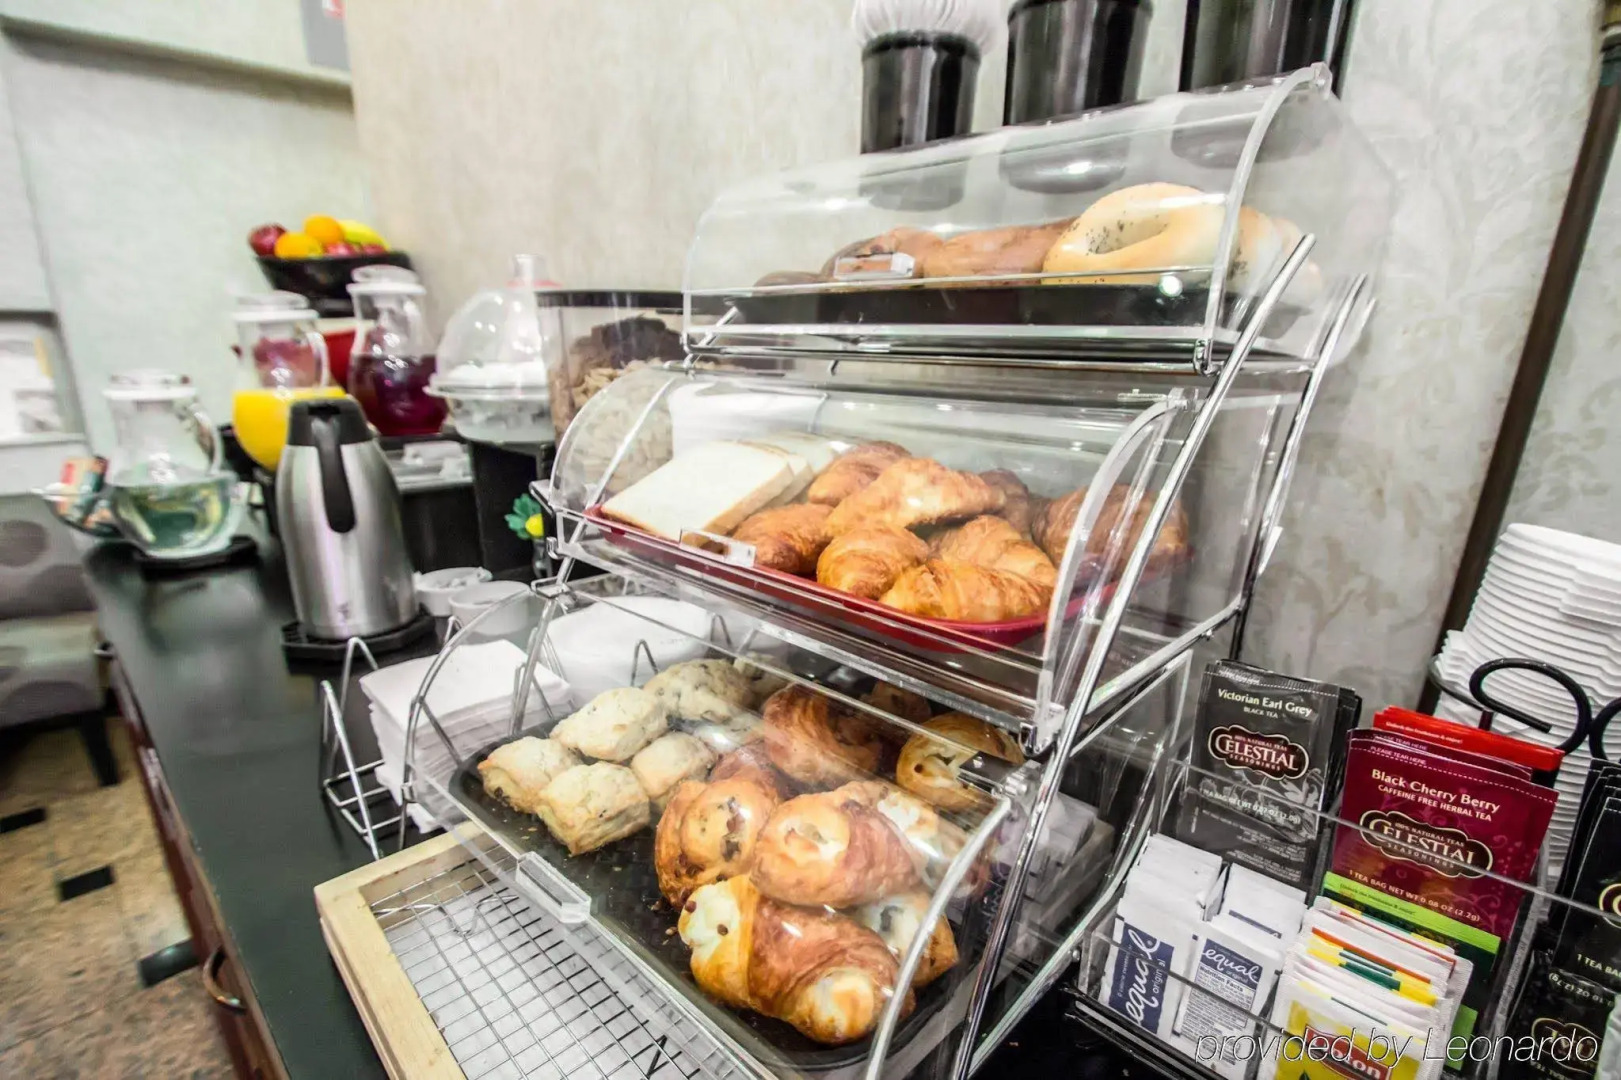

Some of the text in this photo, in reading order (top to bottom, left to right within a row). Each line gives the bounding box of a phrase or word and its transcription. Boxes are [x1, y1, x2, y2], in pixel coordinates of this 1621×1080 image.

[1217, 688, 1313, 718] Victorian Earl Grey
[1243, 706, 1279, 719] BLACK TEA
[1215, 733, 1299, 771] CELESTIAL
[1247, 737, 1272, 748] NATURAL
[1229, 753, 1281, 771] SEASONINGS
[1371, 768, 1501, 814] Black Cherry Berry
[1378, 784, 1492, 822] CAFFEINE FREE HERBAL TEA
[1411, 827, 1445, 841] NATURAL
[1446, 837, 1465, 848] TEAS
[1354, 871, 1369, 883] TEA
[1370, 878, 1387, 889] BAG
[1388, 884, 1405, 896] NET
[1405, 891, 1419, 901] WT
[1440, 904, 1454, 913] OZ
[1454, 908, 1480, 922] (2.2g)
[1125, 928, 1161, 1027] equal
[1201, 949, 1258, 984] equal
[1577, 953, 1583, 961] 1
[1584, 956, 1603, 971] TEA
